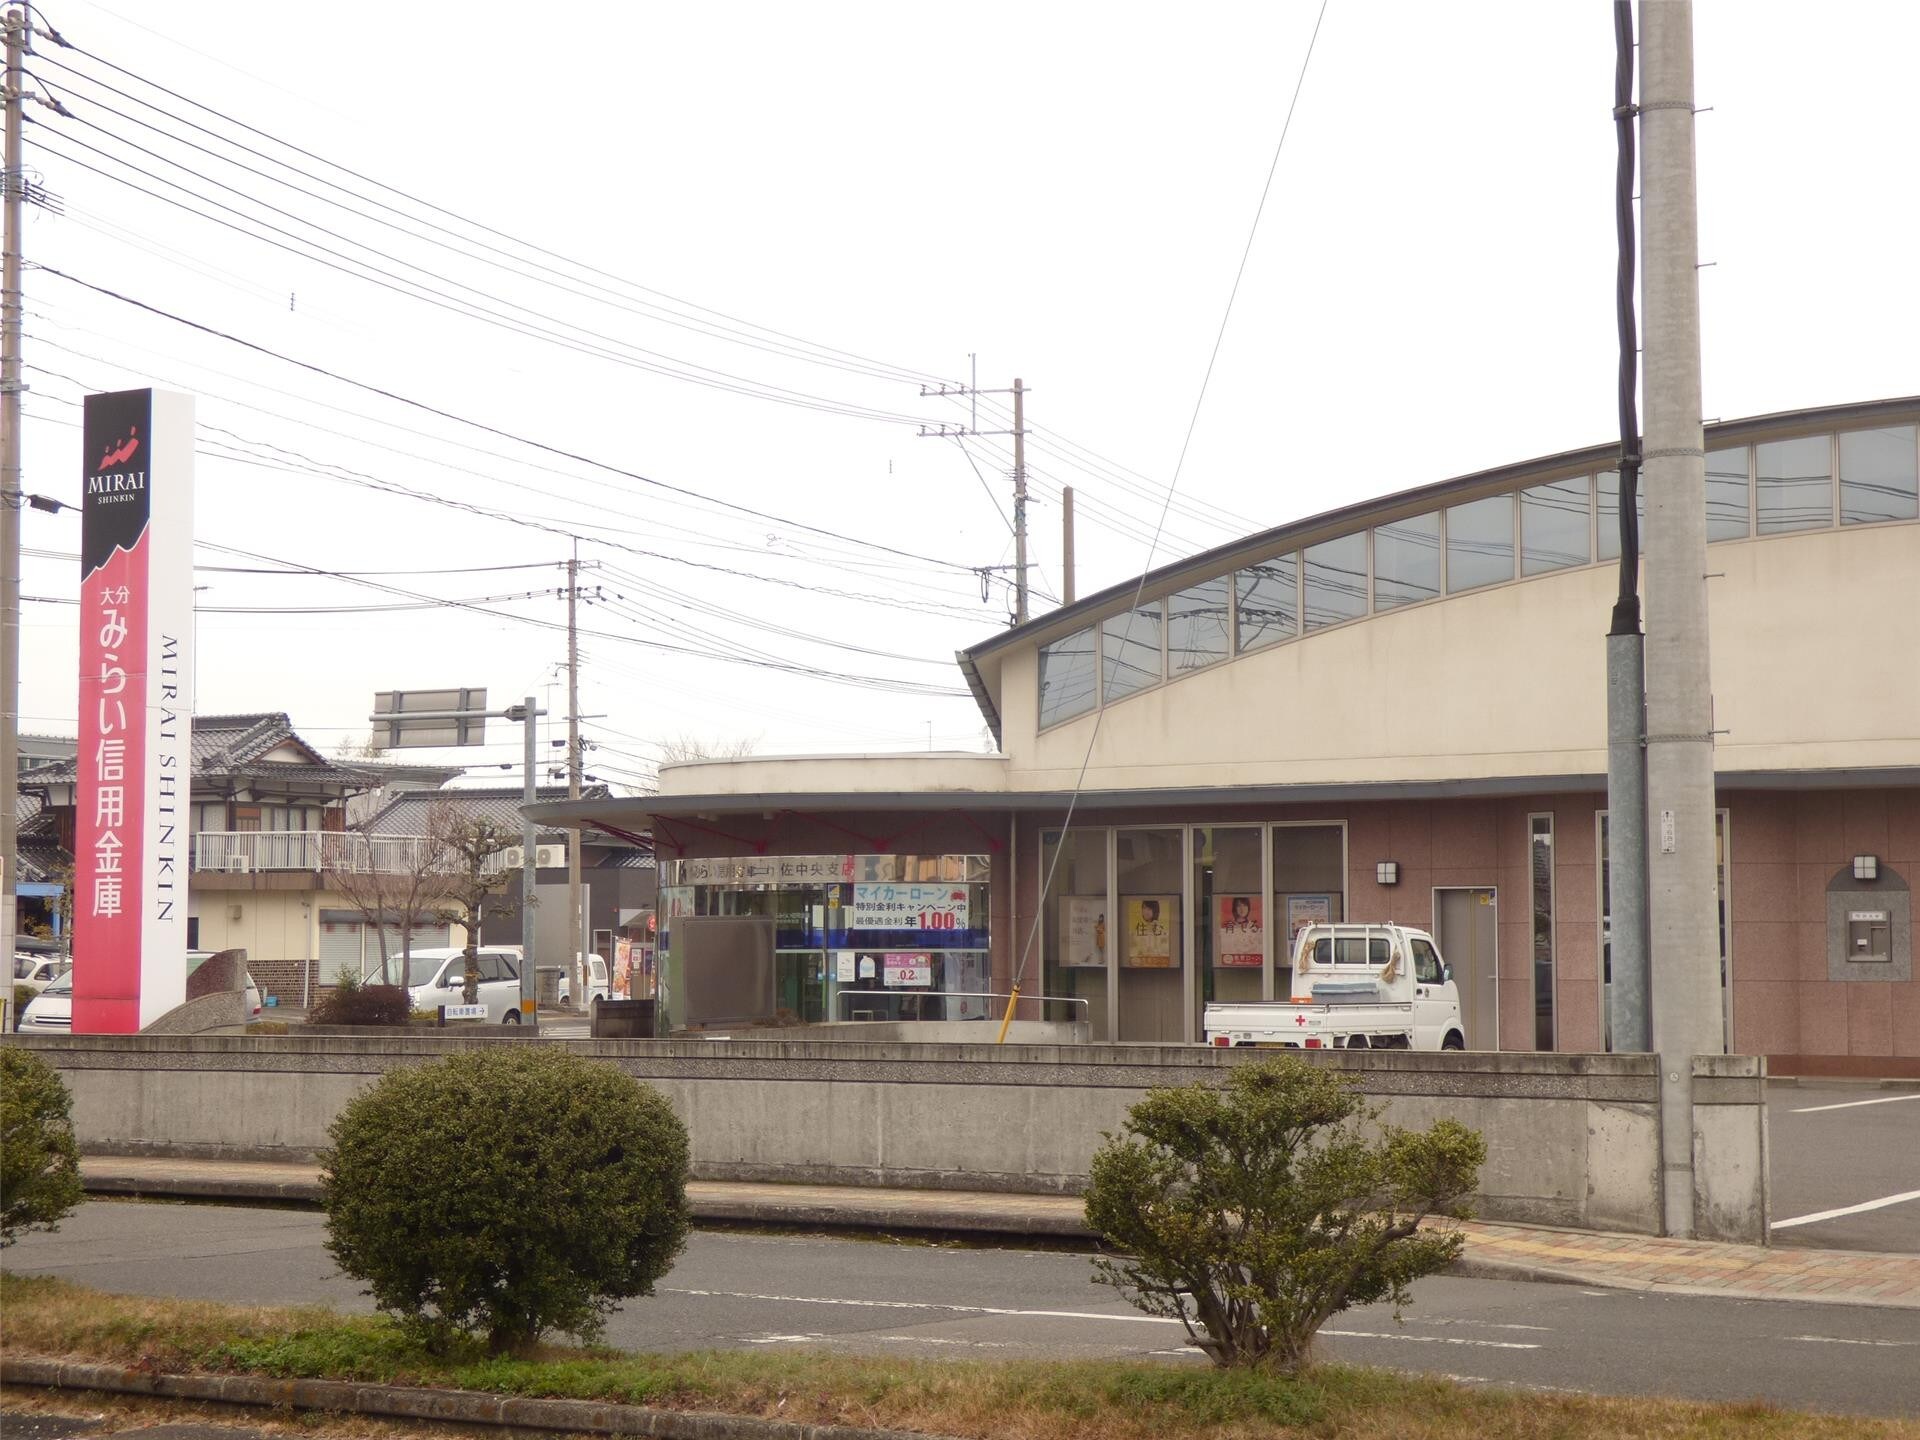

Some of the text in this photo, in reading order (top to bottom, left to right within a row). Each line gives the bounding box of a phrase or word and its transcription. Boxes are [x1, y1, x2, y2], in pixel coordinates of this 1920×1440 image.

[87, 471, 145, 494] MIRAI
[97, 493, 135, 505] SHINKIN
[100, 586, 130, 604] 大分
[93, 609, 128, 918] みらい信用金庫
[157, 635, 178, 922] MIRAI SHINKIN
[855, 885, 949, 901] マイカーローン
